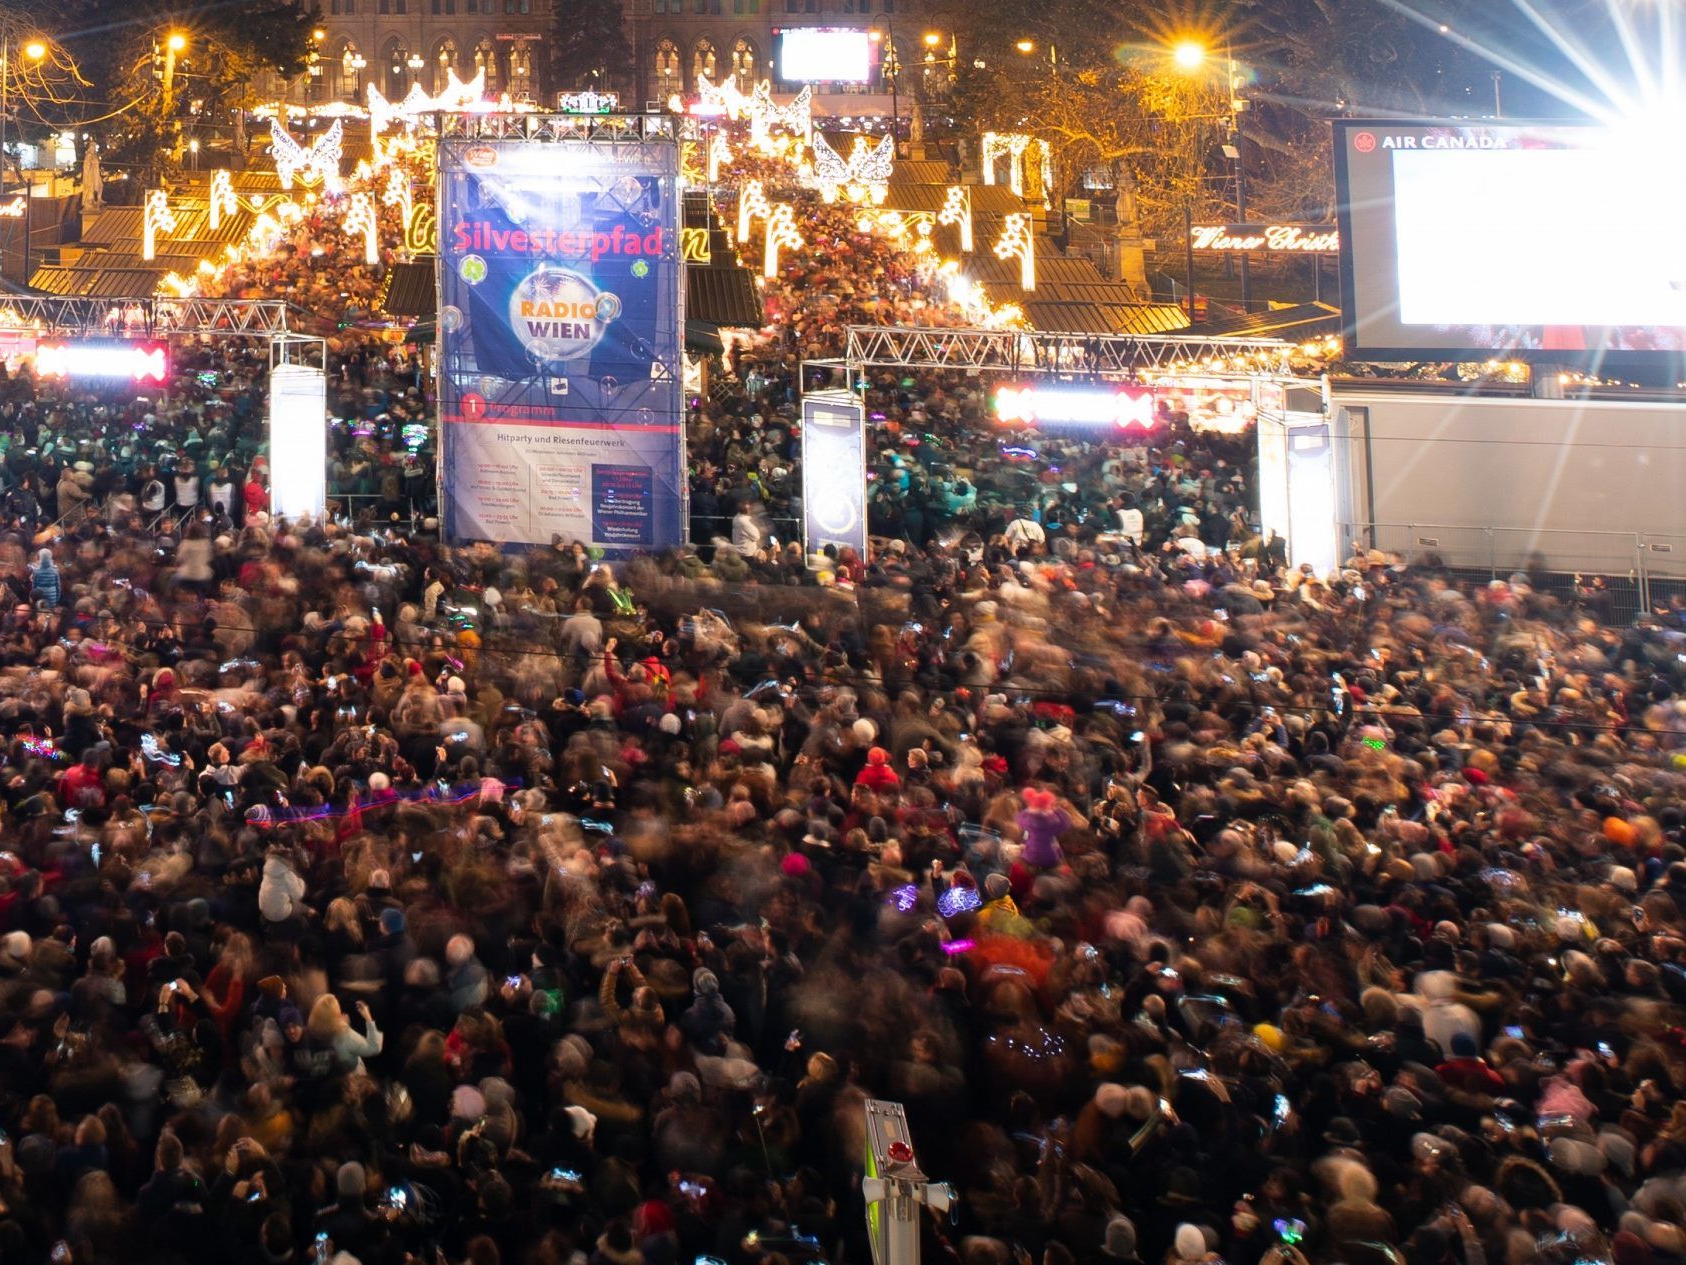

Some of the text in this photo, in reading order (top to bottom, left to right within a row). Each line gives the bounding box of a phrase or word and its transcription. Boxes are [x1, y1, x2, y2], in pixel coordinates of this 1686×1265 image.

[1382, 135, 1507, 149] AIR CANADA
[454, 220, 663, 262] Silvesterpfad
[1191, 225, 1265, 250] Wiener
[521, 300, 596, 319] RADIO
[527, 320, 591, 340] WIEN
[469, 399, 556, 417] 1 Programm
[497, 433, 626, 447] Hitparty und Riesenfeuerwerk
